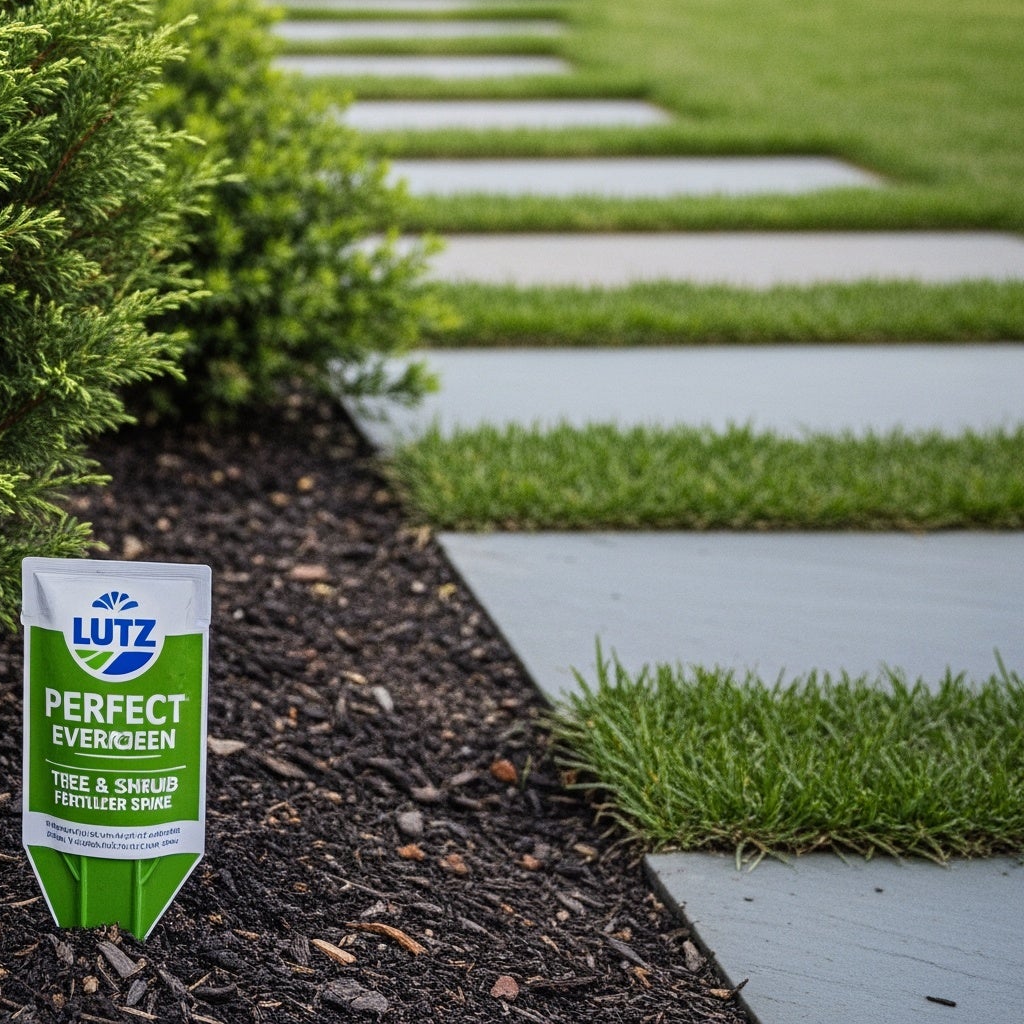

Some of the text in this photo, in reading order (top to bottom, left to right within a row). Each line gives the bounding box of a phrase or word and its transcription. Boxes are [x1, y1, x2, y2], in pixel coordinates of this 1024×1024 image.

[73, 617, 156, 647] LUTZ
[45, 687, 186, 725] PERFECT
[51, 769, 91, 792] TREE
[95, 777, 110, 794] &
